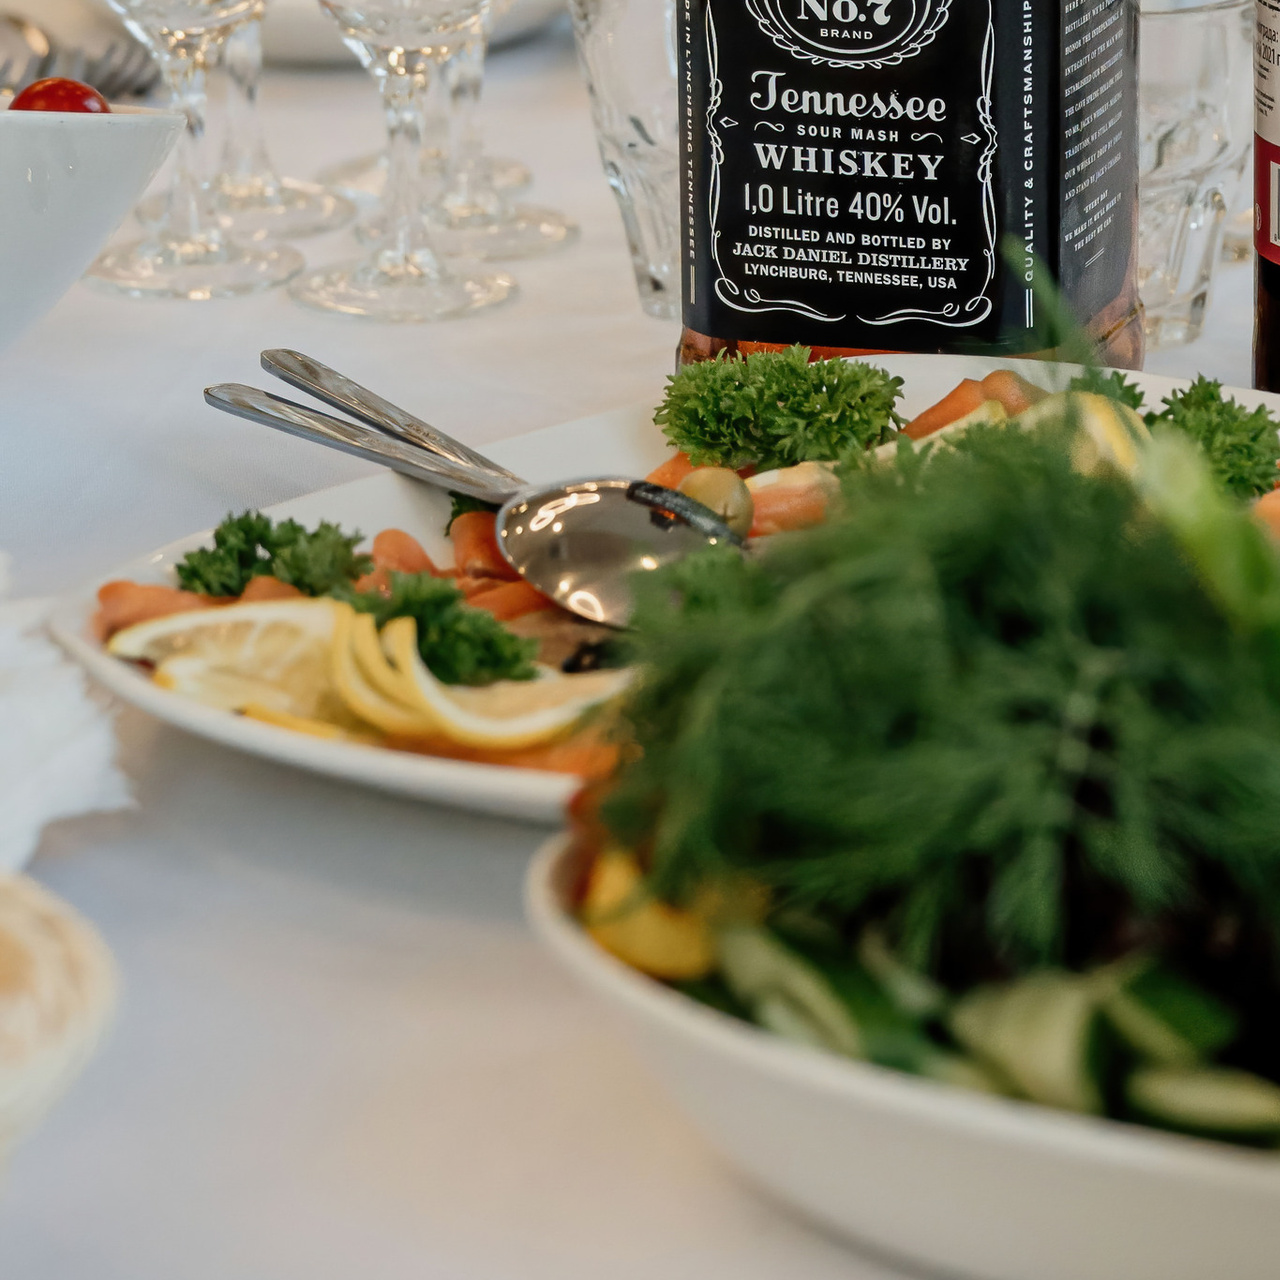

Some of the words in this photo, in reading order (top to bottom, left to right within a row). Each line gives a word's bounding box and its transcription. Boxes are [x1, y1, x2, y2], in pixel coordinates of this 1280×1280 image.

[685, 26, 691, 44] IN
[820, 28, 874, 40] BRAND
[685, 50, 693, 154] LYNCHBURG
[750, 70, 947, 122] Tennessee
[1023, 0, 1033, 171] CRAFTSMANSHIP
[797, 124, 842, 139] SOUR
[851, 128, 899, 142] MASH
[753, 142, 945, 180] WHISKEY
[1024, 178, 1033, 189] &
[688, 160, 696, 260] TENNESSEE
[744, 183, 774, 214] 1,0
[783, 186, 839, 218] Litre
[848, 192, 905, 223] 40%
[912, 195, 957, 226] Vol.
[749, 225, 820, 242] DISTILLED
[826, 231, 855, 245] AND
[861, 234, 926, 250] BOTTLED
[932, 238, 951, 250] BY
[1024, 197, 1034, 282] QUALITY
[732, 243, 778, 259] JACK
[783, 246, 852, 265] DANIEL
[857, 252, 970, 271] DISTILLERY
[744, 263, 833, 283] LYNCHBURG,
[837, 270, 923, 289] TENNESSEE,
[928, 276, 957, 289] USA
